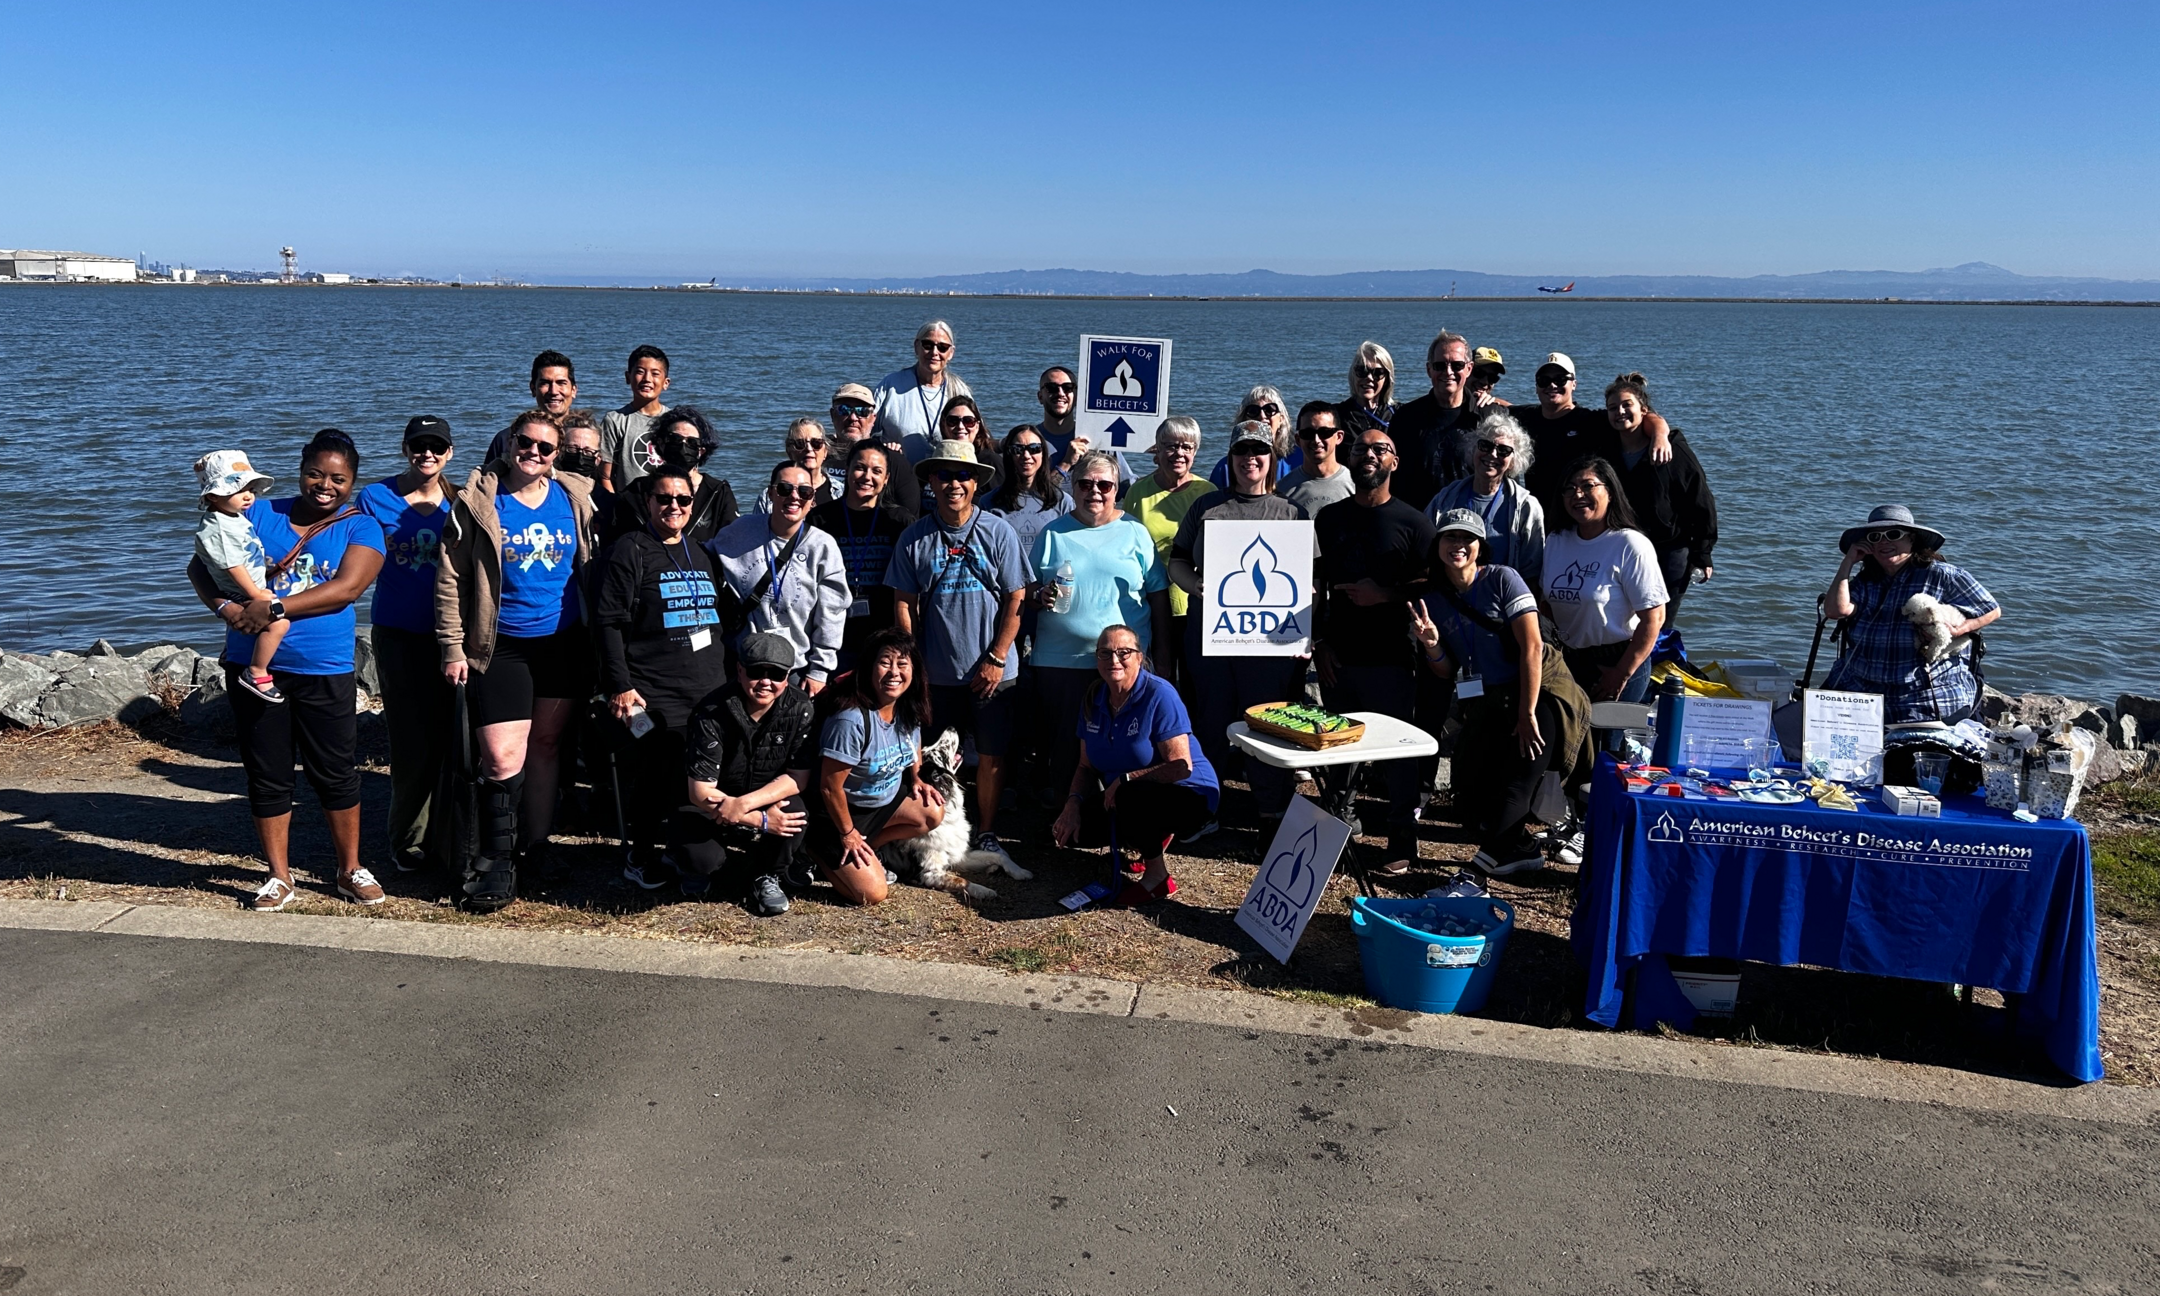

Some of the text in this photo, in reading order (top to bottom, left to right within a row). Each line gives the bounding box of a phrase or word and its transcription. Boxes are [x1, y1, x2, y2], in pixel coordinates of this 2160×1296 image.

[1097, 345, 1153, 361] WALK FOR
[1096, 398, 1149, 410] BEHCET'S
[500, 528, 572, 545] Behcets
[504, 545, 564, 564] Buddy
[1580, 561, 1600, 577] 40
[669, 584, 713, 594] EDUCATE
[941, 580, 978, 590] THRIVE
[1549, 590, 1581, 601] ABDA
[1212, 610, 1302, 634] ABDA
[874, 742, 908, 759] ADVOCA
[1689, 818, 2032, 858] American Behcet's Disease Association
[1690, 836, 2028, 869] AWARENESS RESEARCH CURE PREVENTION
[1248, 886, 1298, 940] ABDA
